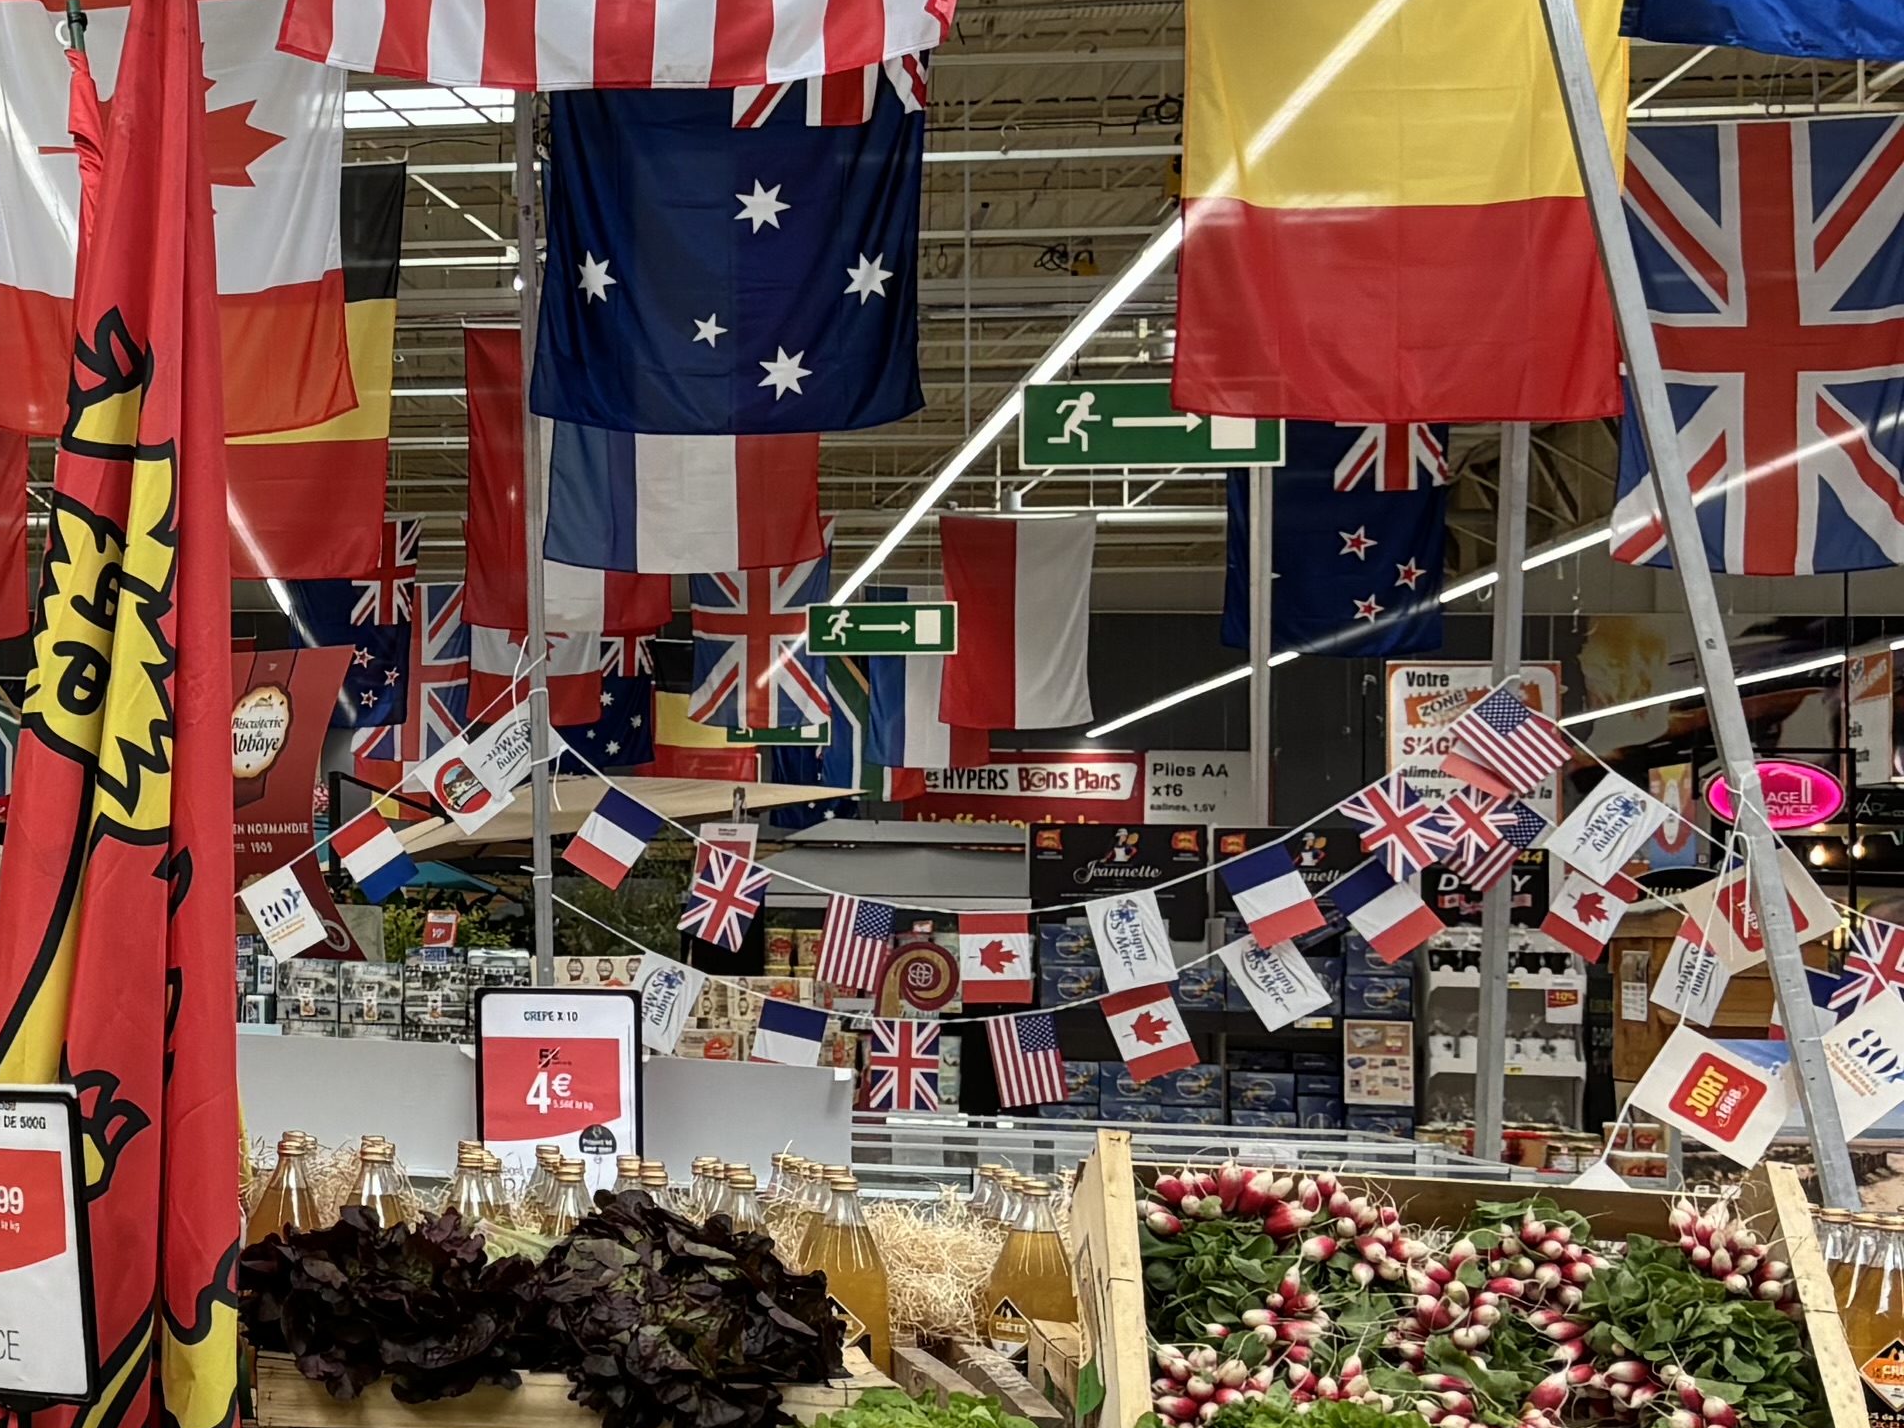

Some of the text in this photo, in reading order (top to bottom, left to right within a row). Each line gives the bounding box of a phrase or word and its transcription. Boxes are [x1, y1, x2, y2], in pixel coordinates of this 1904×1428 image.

[1406, 671, 1450, 687] Votre
[1420, 690, 1465, 717] ZONE
[943, 767, 1009, 791] HYPERS
[1074, 767, 1122, 793] Plans
[1152, 762, 1229, 778] Piles AA
[1152, 783, 1184, 797] x16
[247, 822, 309, 835] NORMANDIE
[1073, 859, 1162, 884] Jeannette
[566, 1011, 578, 1022] 10
[525, 1071, 572, 1114] 4€
[1684, 1065, 1729, 1118] JORT
[1715, 1088, 1742, 1120] 1888
[3, 1115, 17, 1128] DE
[20, 1115, 46, 1130] 500G
